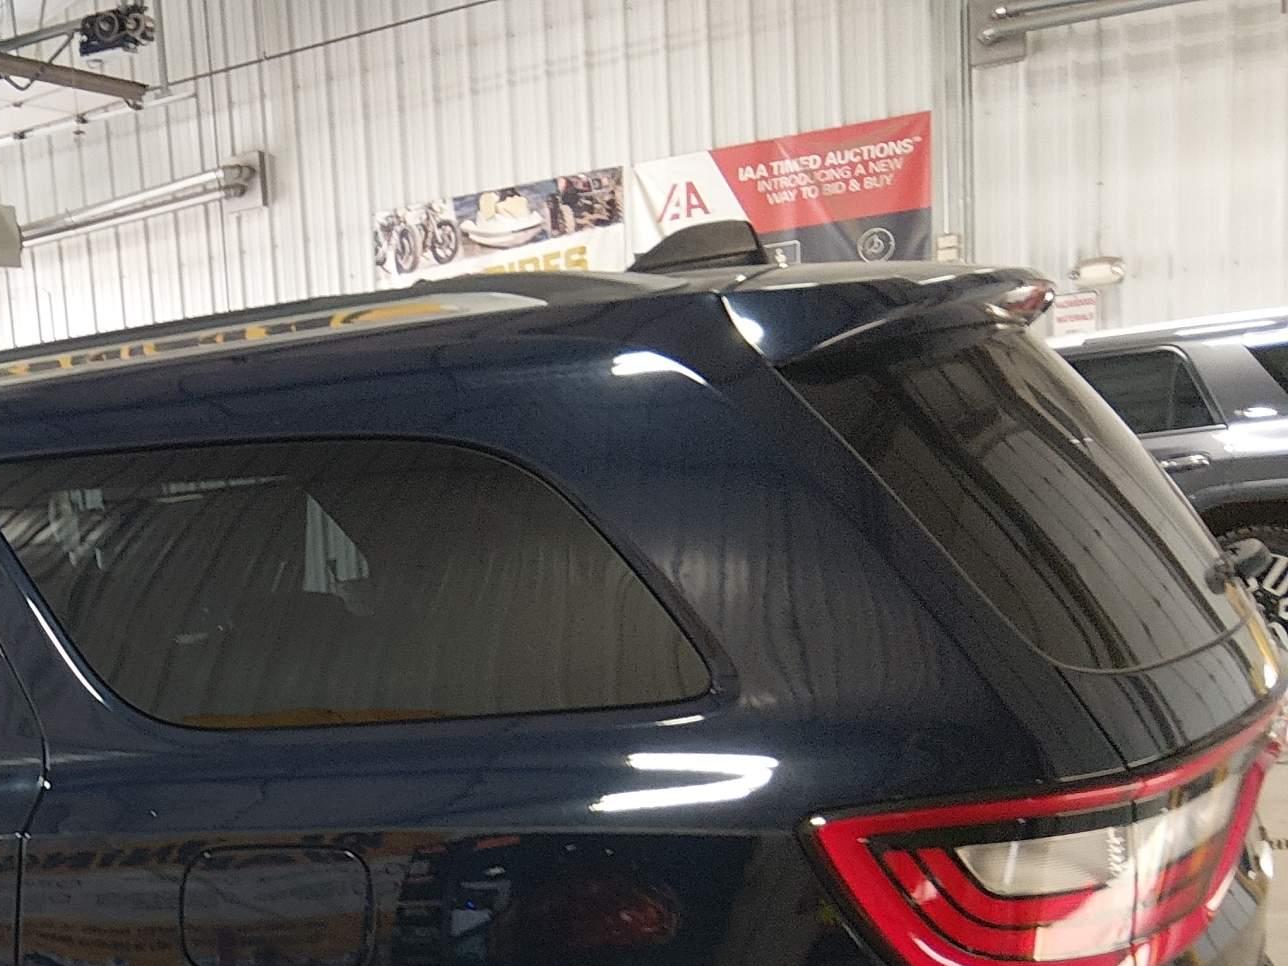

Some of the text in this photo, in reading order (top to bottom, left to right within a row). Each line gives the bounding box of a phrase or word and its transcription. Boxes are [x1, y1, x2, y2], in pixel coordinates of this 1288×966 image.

[738, 163, 768, 182] IAA
[770, 155, 822, 175] TIMED
[854, 163, 867, 177] A
[868, 157, 905, 173] NEW
[766, 173, 895, 205] WAY TO BID & BUY
